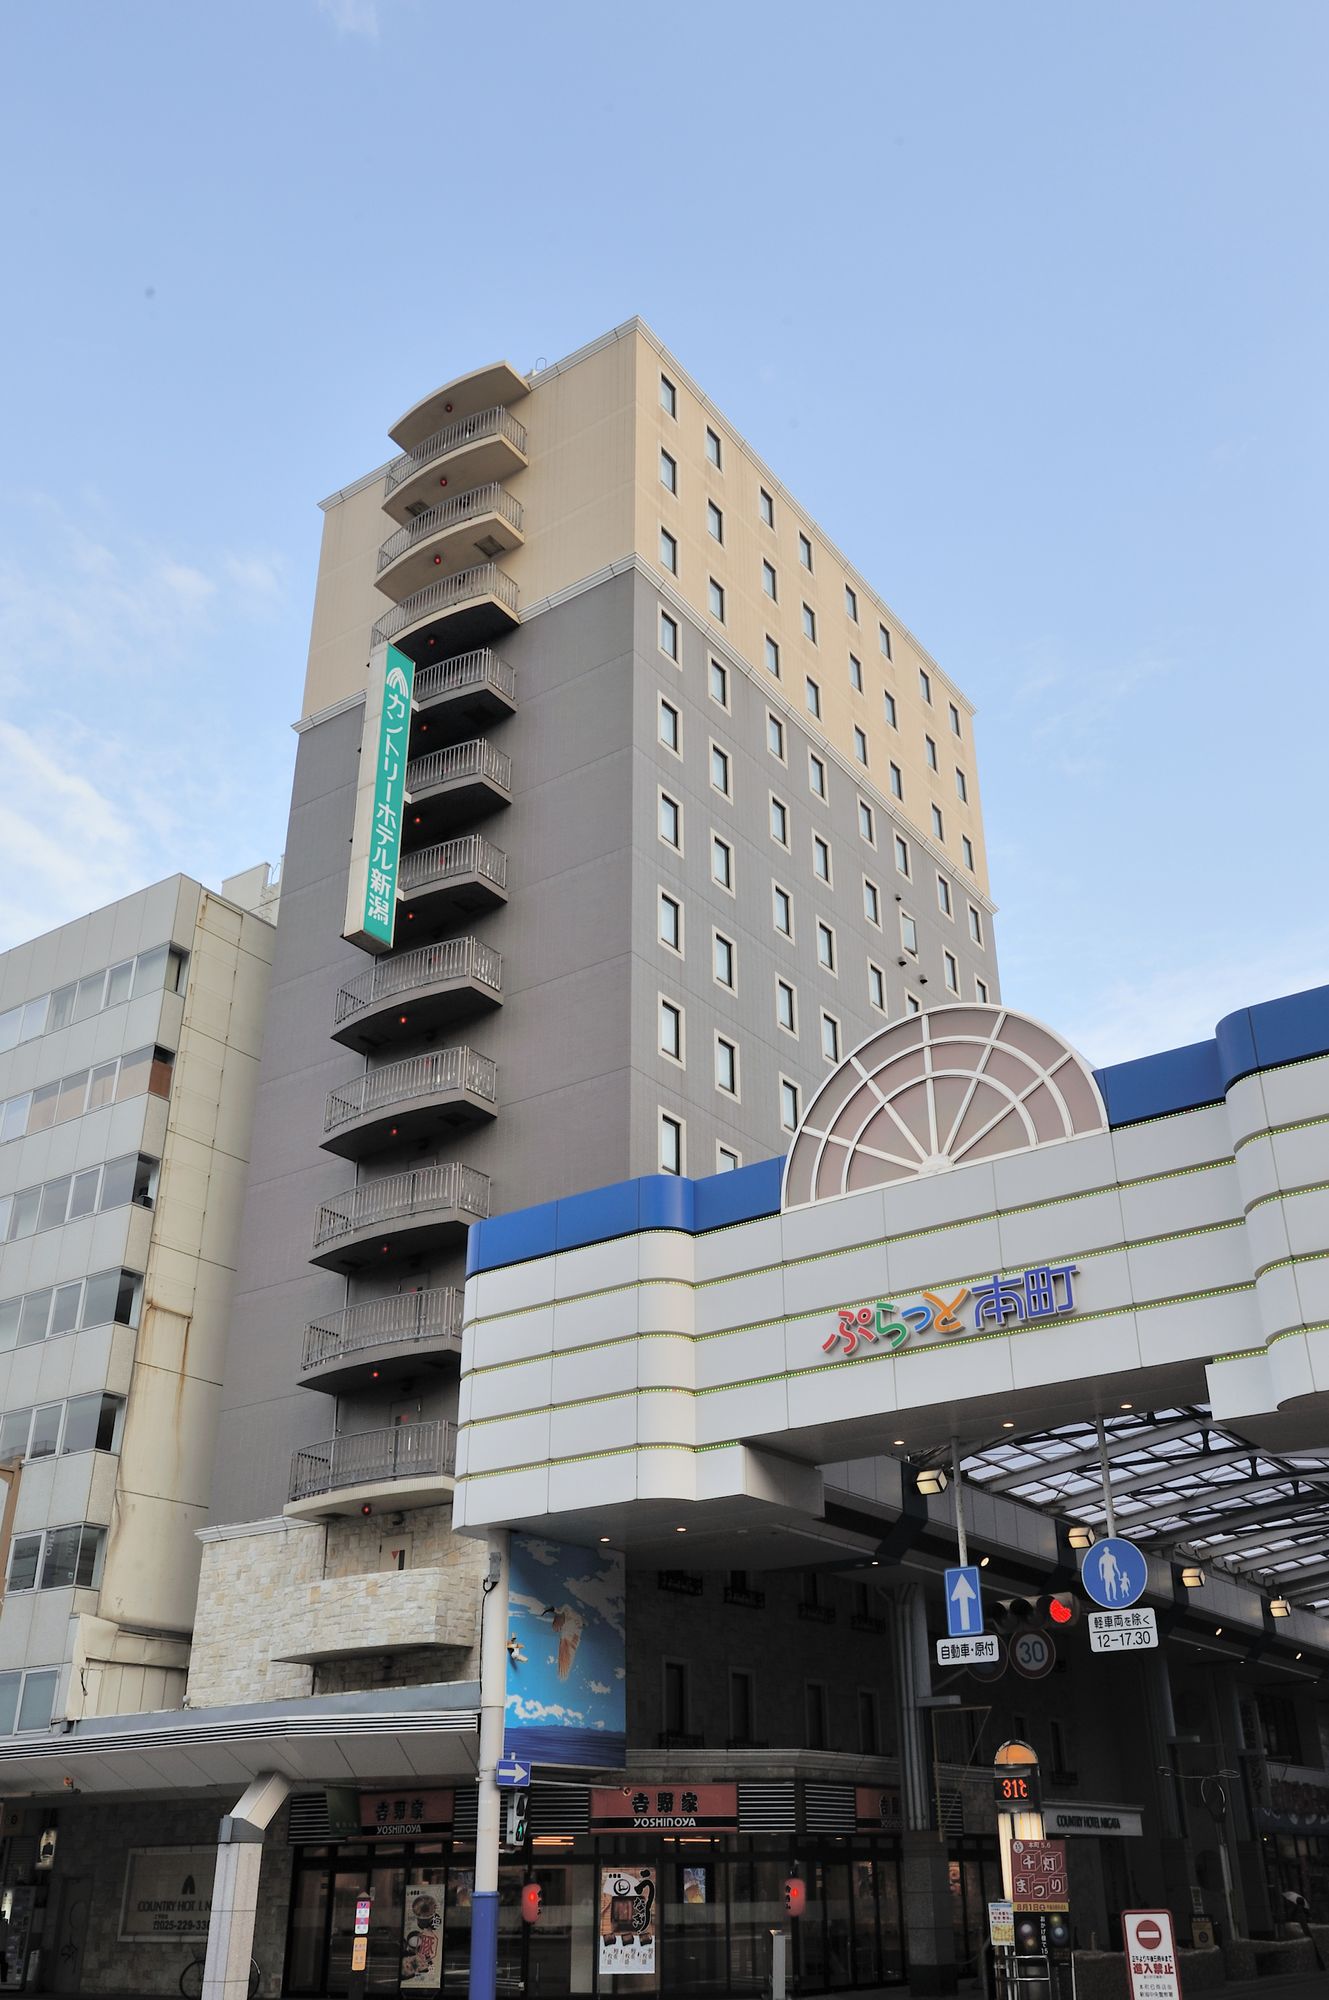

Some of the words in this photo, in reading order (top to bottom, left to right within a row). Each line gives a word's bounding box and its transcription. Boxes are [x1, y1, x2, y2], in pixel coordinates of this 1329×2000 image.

[367, 693, 405, 926] カントリーホテル新潟
[821, 1265, 1080, 1356] ぷらっと本町
[1093, 1613, 1150, 1629] 軽車両を除く
[941, 1642, 994, 1660] 自動車・原付
[1019, 1640, 1045, 1664] 30
[632, 1791, 698, 1814] 吉野家
[633, 1817, 697, 1828] YOSHINOYA
[1056, 1814, 1083, 1828] COUNTRY
[1083, 1815, 1100, 1828] HOTEL
[376, 1824, 422, 1836] YOSHINOYA
[137, 1900, 176, 1913] COUNTRY
[1133, 1963, 1174, 1975] 進入禁止
